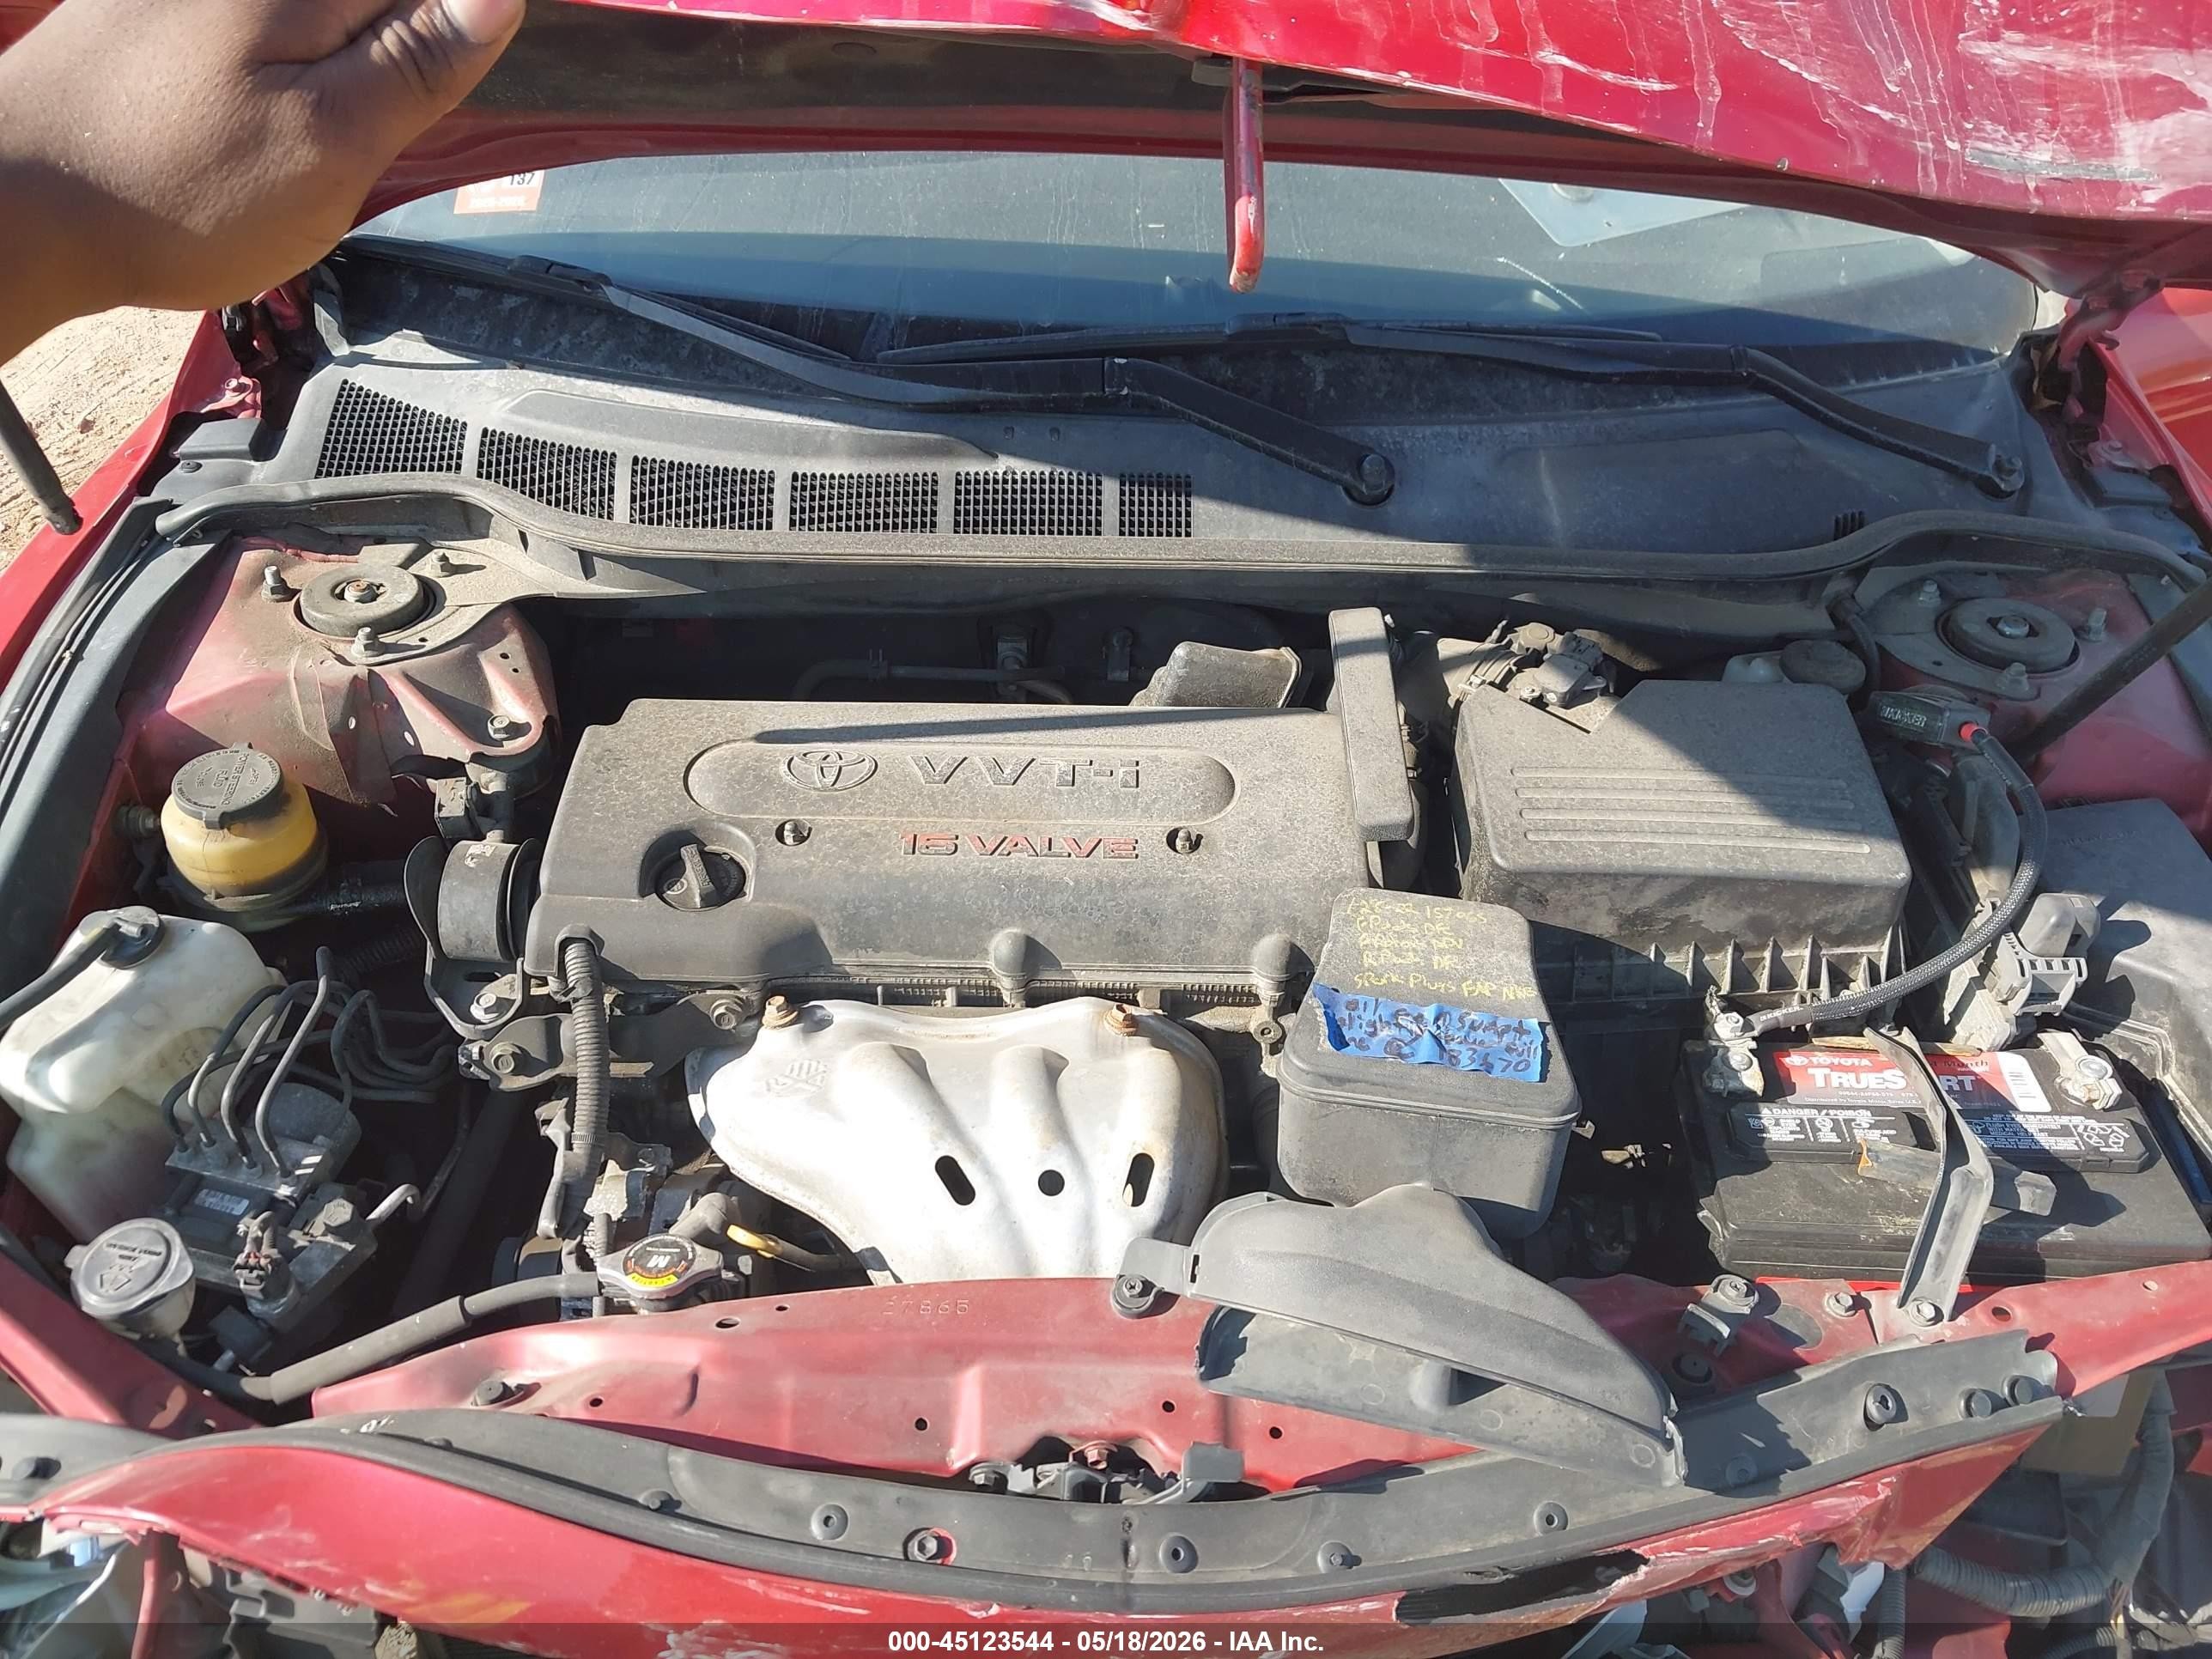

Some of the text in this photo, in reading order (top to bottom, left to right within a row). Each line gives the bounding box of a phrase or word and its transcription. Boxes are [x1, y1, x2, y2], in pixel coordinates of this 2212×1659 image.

[908, 755, 1141, 789] VVT-i
[899, 831, 1140, 860] 16 VALVE
[1808, 1056, 1873, 1066] TOYOTA
[1772, 1109, 1820, 1117] DANGER
